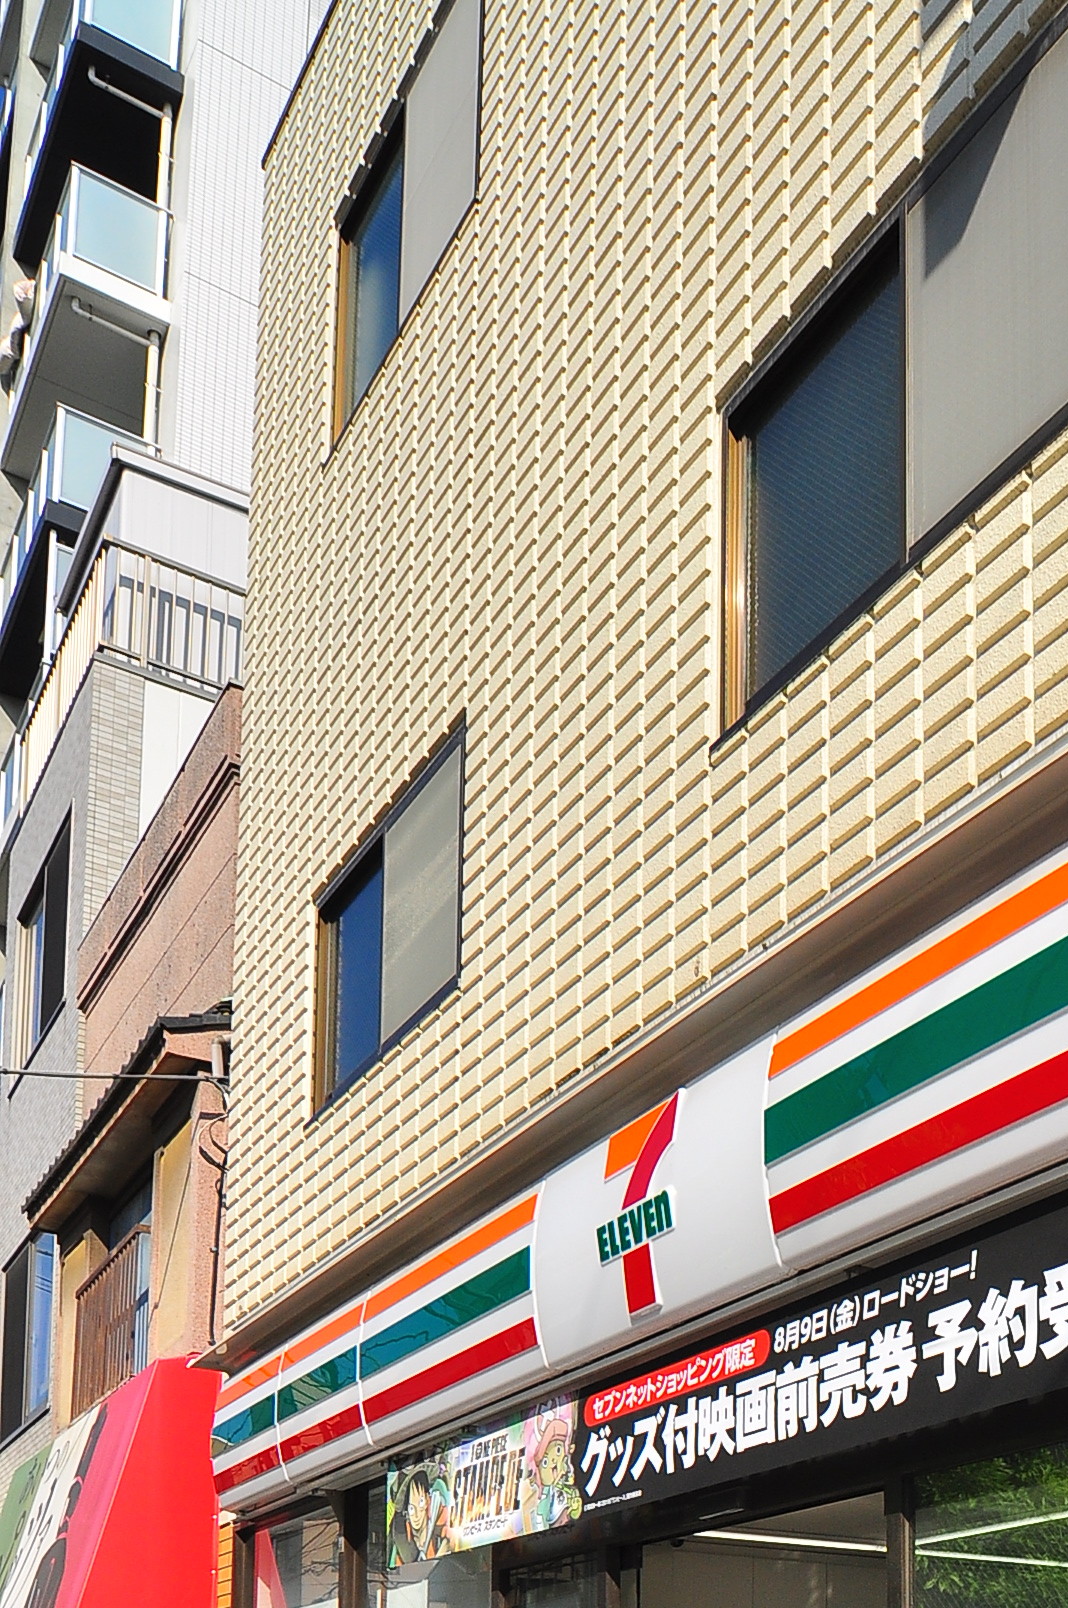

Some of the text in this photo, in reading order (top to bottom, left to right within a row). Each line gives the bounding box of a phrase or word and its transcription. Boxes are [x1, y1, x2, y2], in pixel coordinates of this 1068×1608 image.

[592, 1338, 756, 1420] セブンネットショッピング限定
